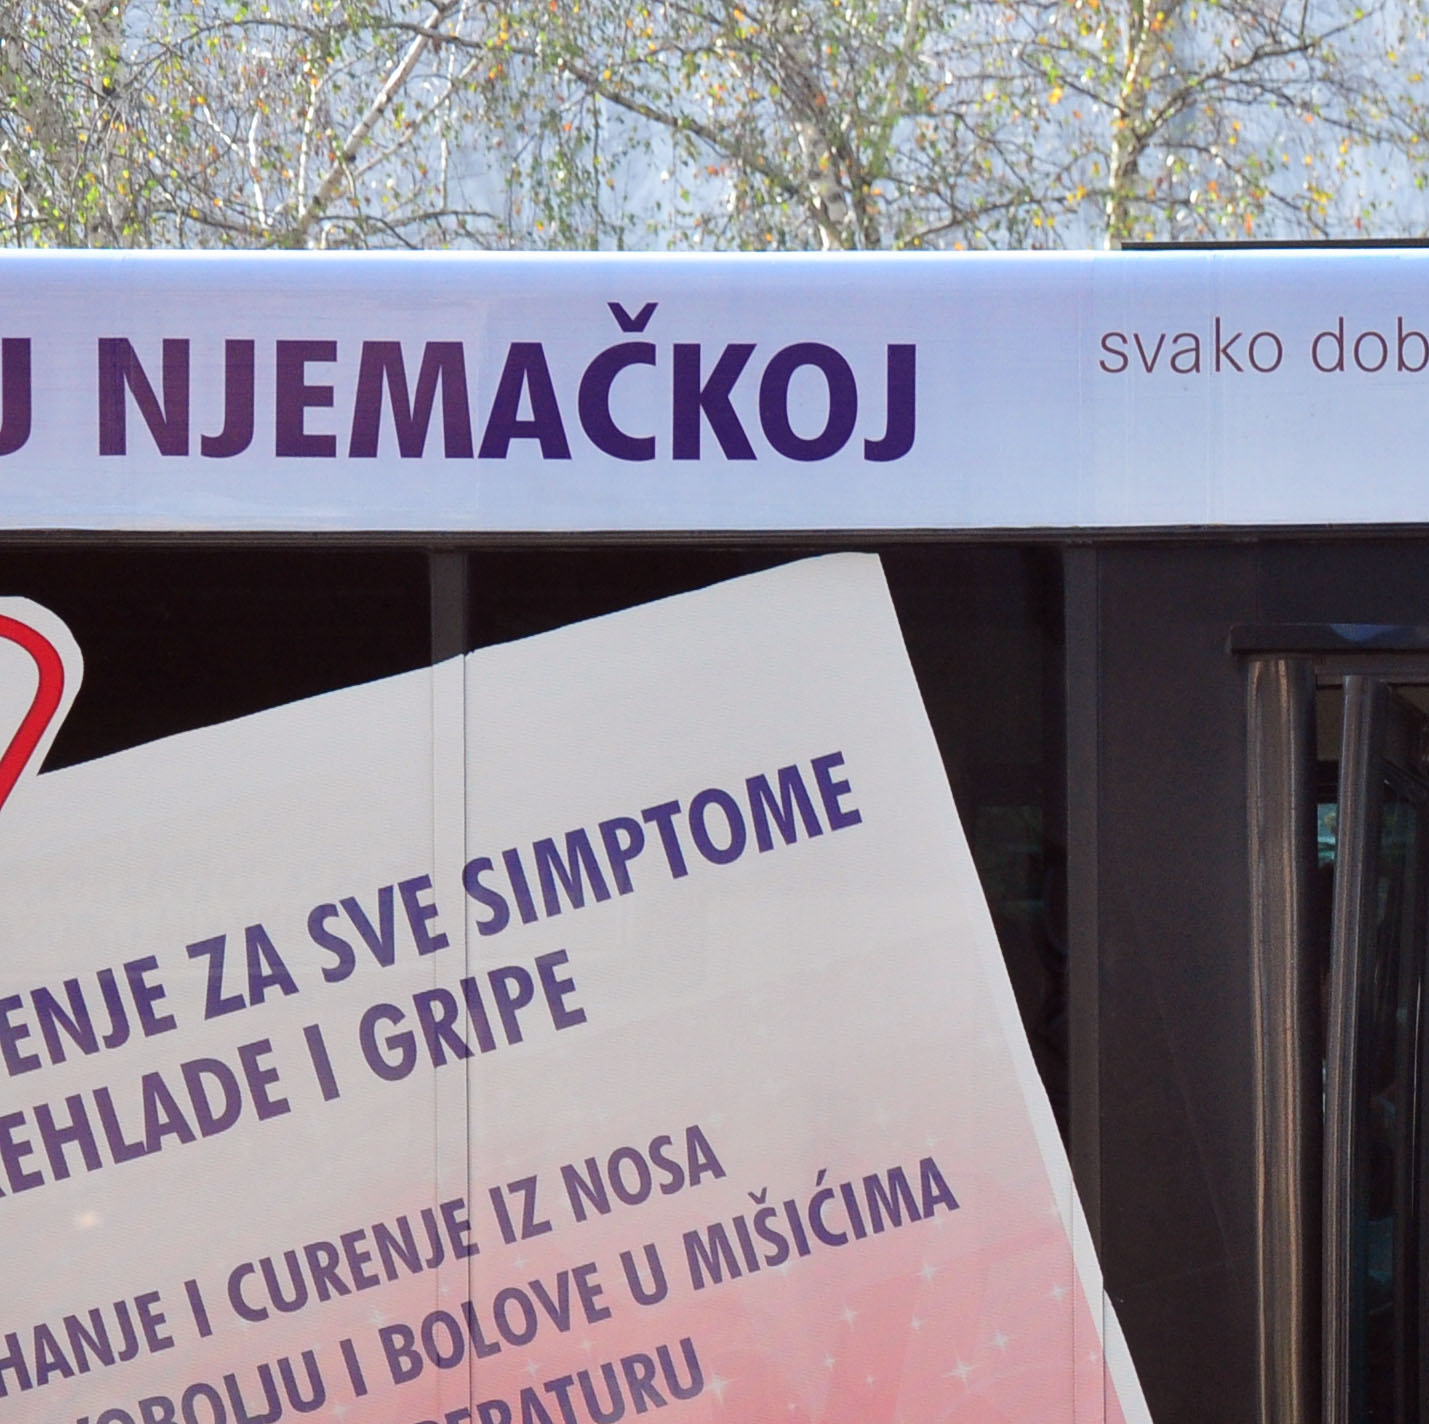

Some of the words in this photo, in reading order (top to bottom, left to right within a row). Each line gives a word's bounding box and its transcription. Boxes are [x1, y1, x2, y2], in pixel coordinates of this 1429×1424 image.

[99, 302, 917, 462] NJEMAČKOJ
[1099, 315, 1283, 375] svako
[186, 924, 300, 1020] ZA
[308, 874, 450, 983] SVE
[462, 750, 863, 935] SIMPTOME
[0, 1038, 292, 1195] EHLADE
[303, 1023, 340, 1102] I
[360, 949, 587, 1082] GRIPE
[184, 1279, 214, 1338] I
[227, 1196, 480, 1323] CURENJE
[489, 1175, 553, 1246] IZ
[560, 1125, 726, 1222] NOSA
[340, 1337, 369, 1398] I
[378, 1262, 612, 1386] BOLOVE
[619, 1243, 669, 1306] U
[682, 1156, 961, 1290] MIŠIĆIMA
